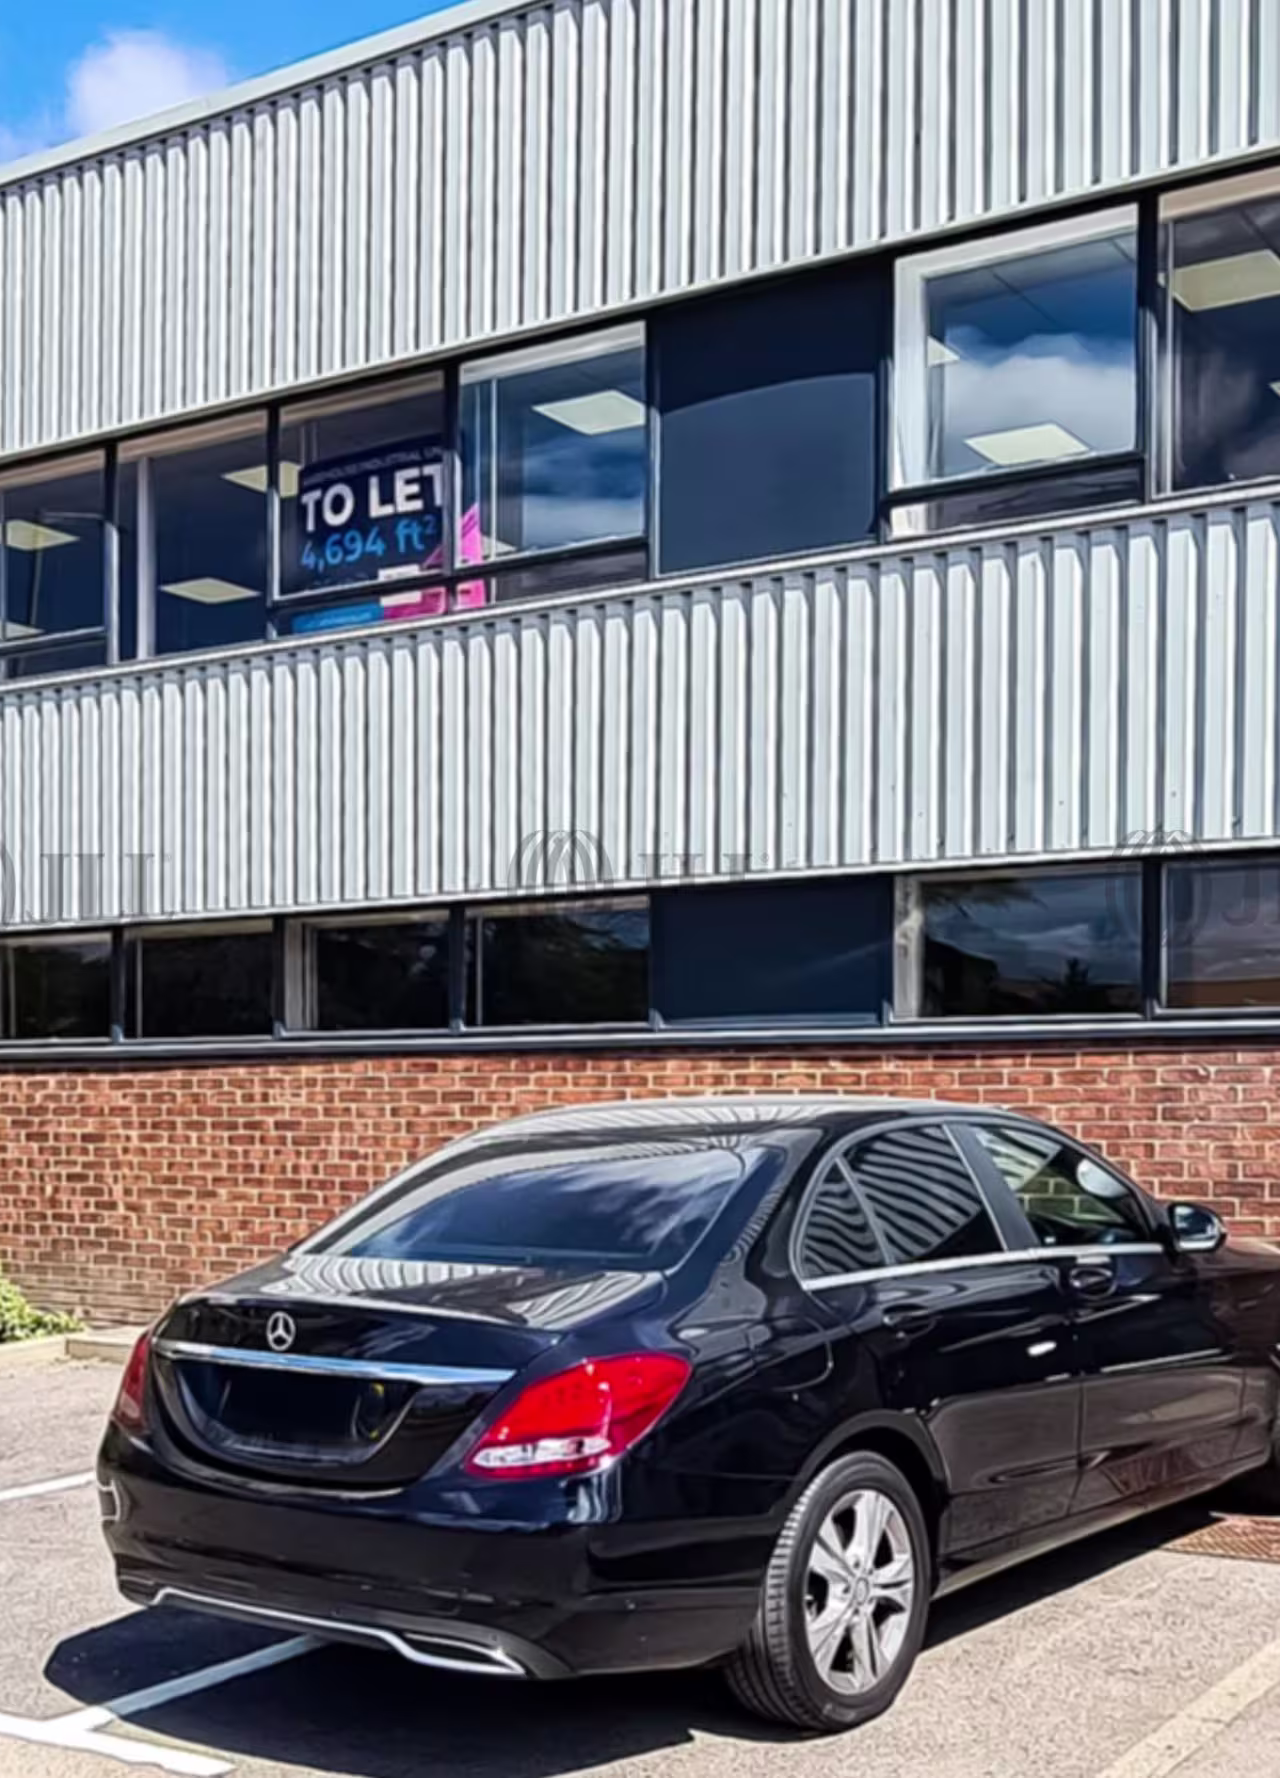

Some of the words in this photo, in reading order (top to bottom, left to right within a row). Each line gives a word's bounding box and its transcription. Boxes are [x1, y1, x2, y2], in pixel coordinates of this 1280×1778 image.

[302, 483, 355, 533] TO
[369, 465, 443, 518] LET
[301, 527, 385, 572] 4,694
